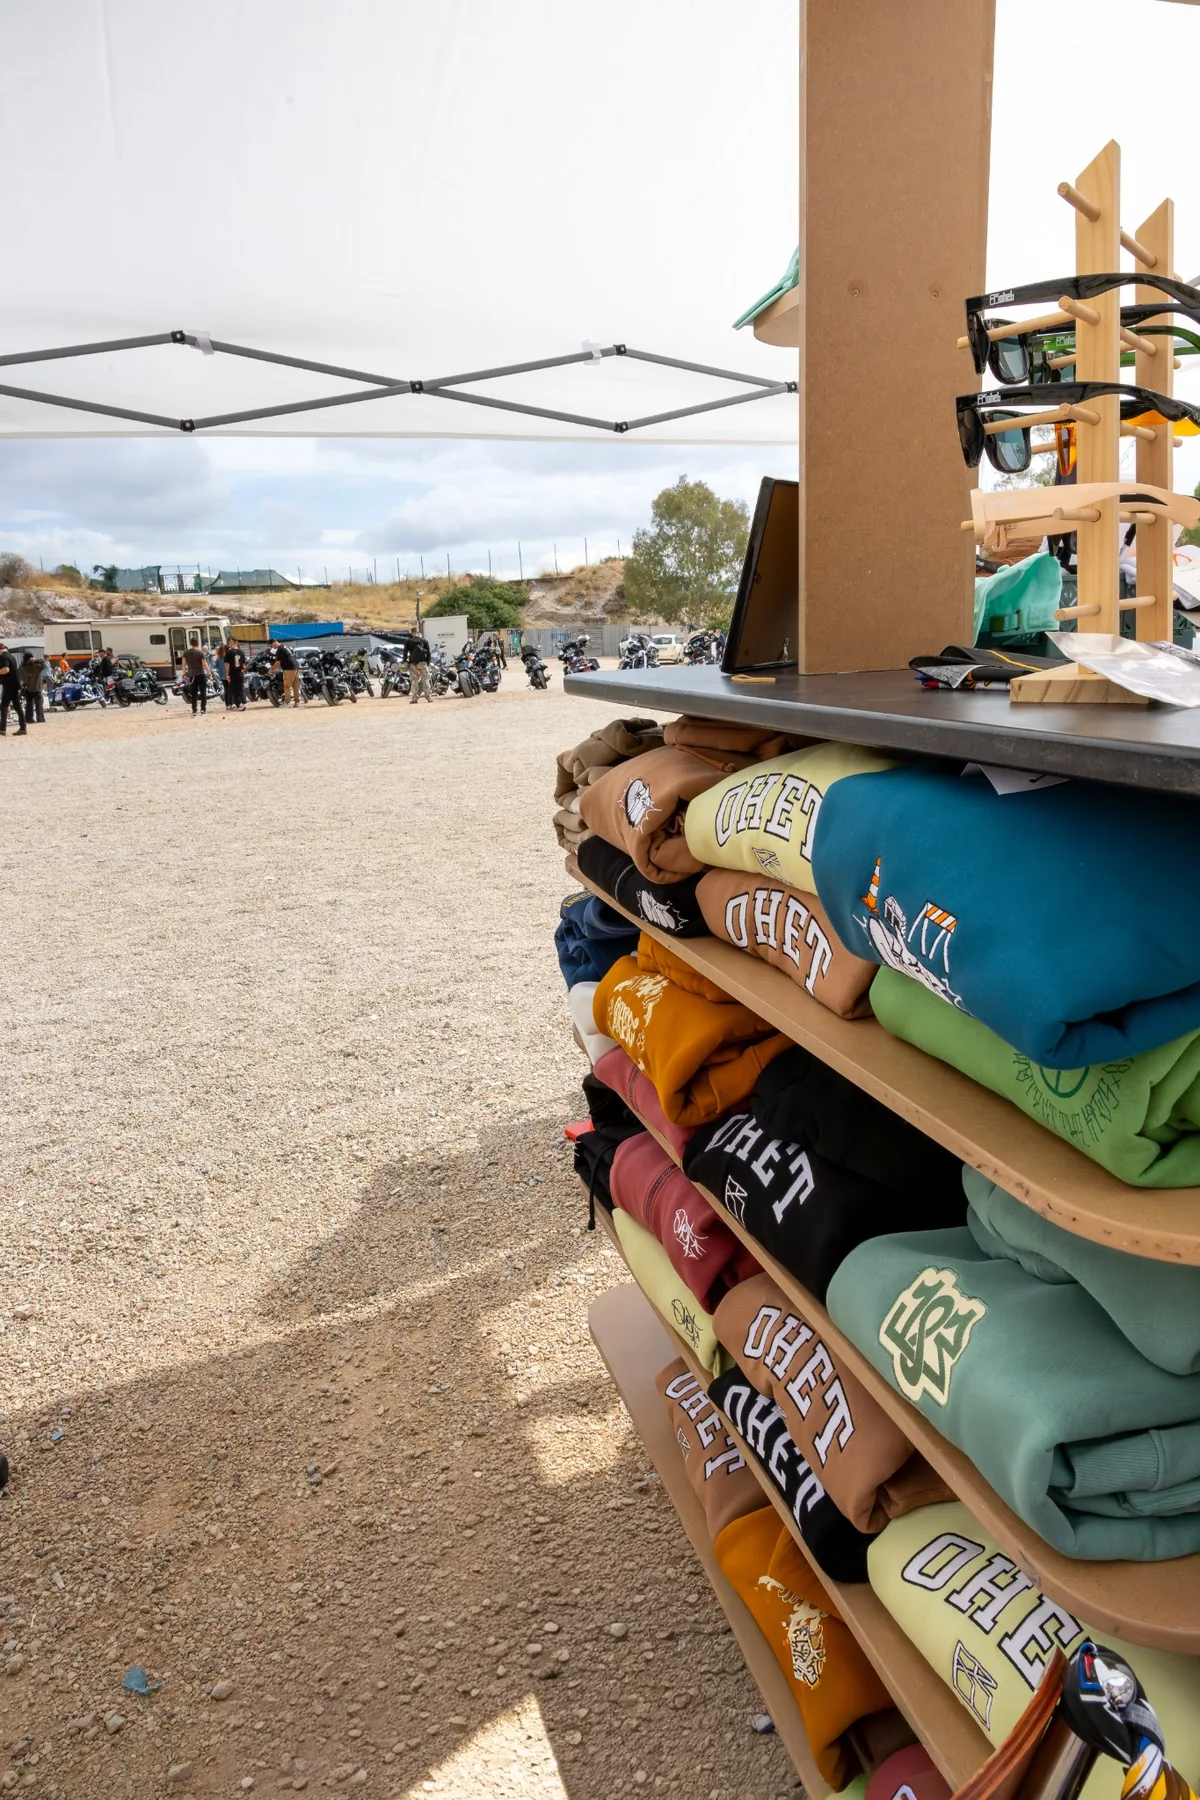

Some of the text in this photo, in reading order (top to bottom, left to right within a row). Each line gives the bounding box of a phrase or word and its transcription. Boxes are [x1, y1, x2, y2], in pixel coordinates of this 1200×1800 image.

[724, 887, 834, 997] OHET
[704, 1113, 815, 1225] OHET
[742, 1304, 856, 1469] OHET
[901, 1532, 1090, 1692] OHE
